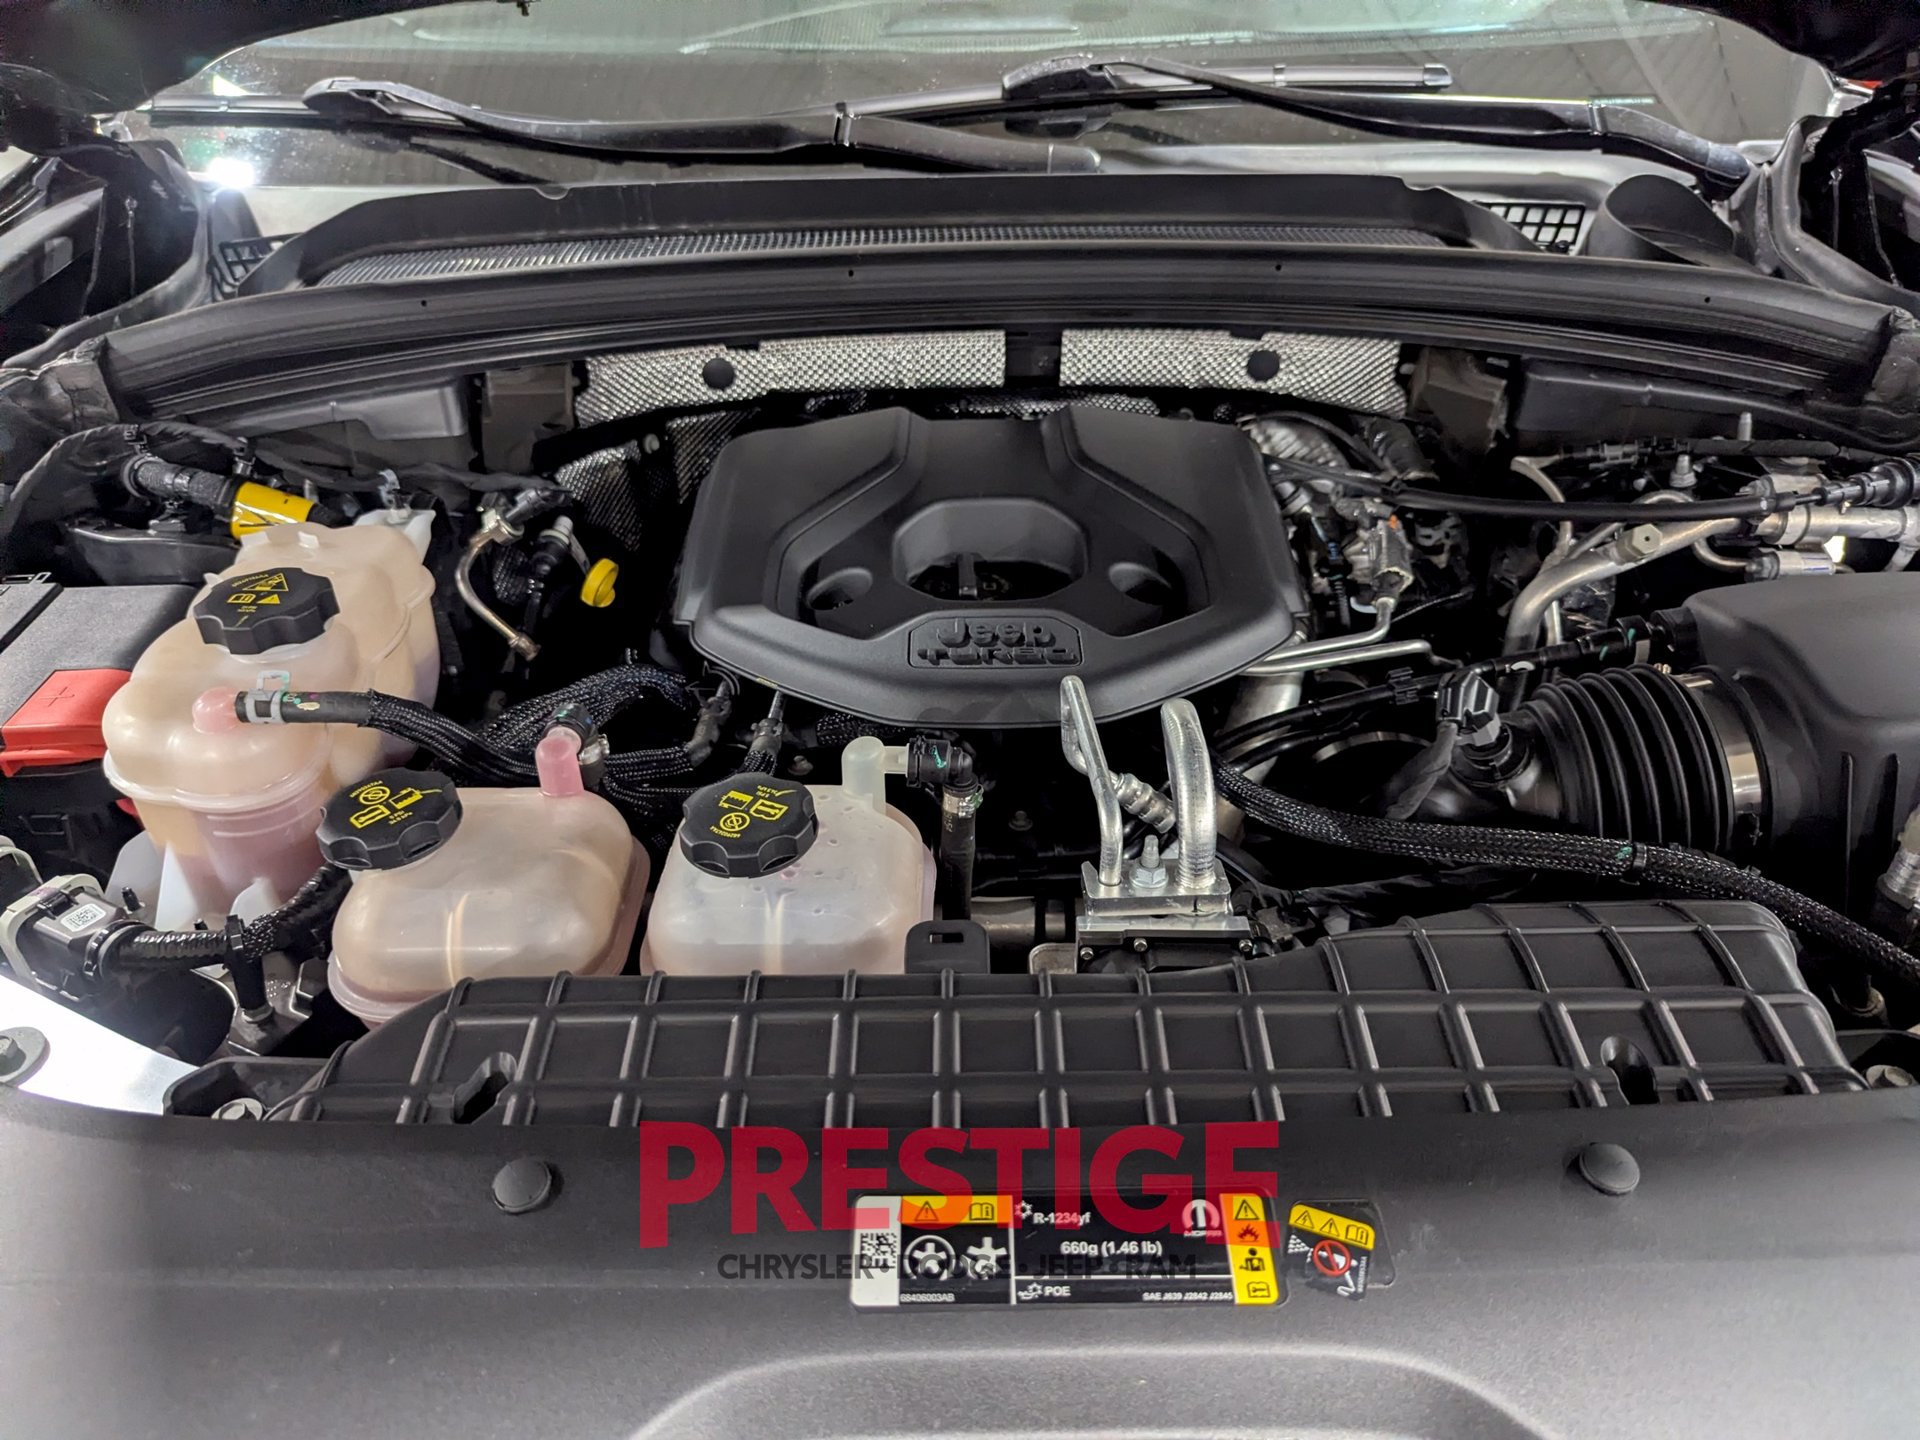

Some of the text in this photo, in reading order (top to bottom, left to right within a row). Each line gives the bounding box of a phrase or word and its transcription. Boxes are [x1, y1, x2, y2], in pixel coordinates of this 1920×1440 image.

[937, 617, 1056, 648] Jeep
[917, 647, 1079, 666] TURBO
[1033, 1212, 1091, 1226] R-1234yf
[1060, 1241, 1162, 1256] 660g (1.46 lb)
[1044, 1285, 1071, 1297] POE
[1142, 1291, 1161, 1301] SAE
